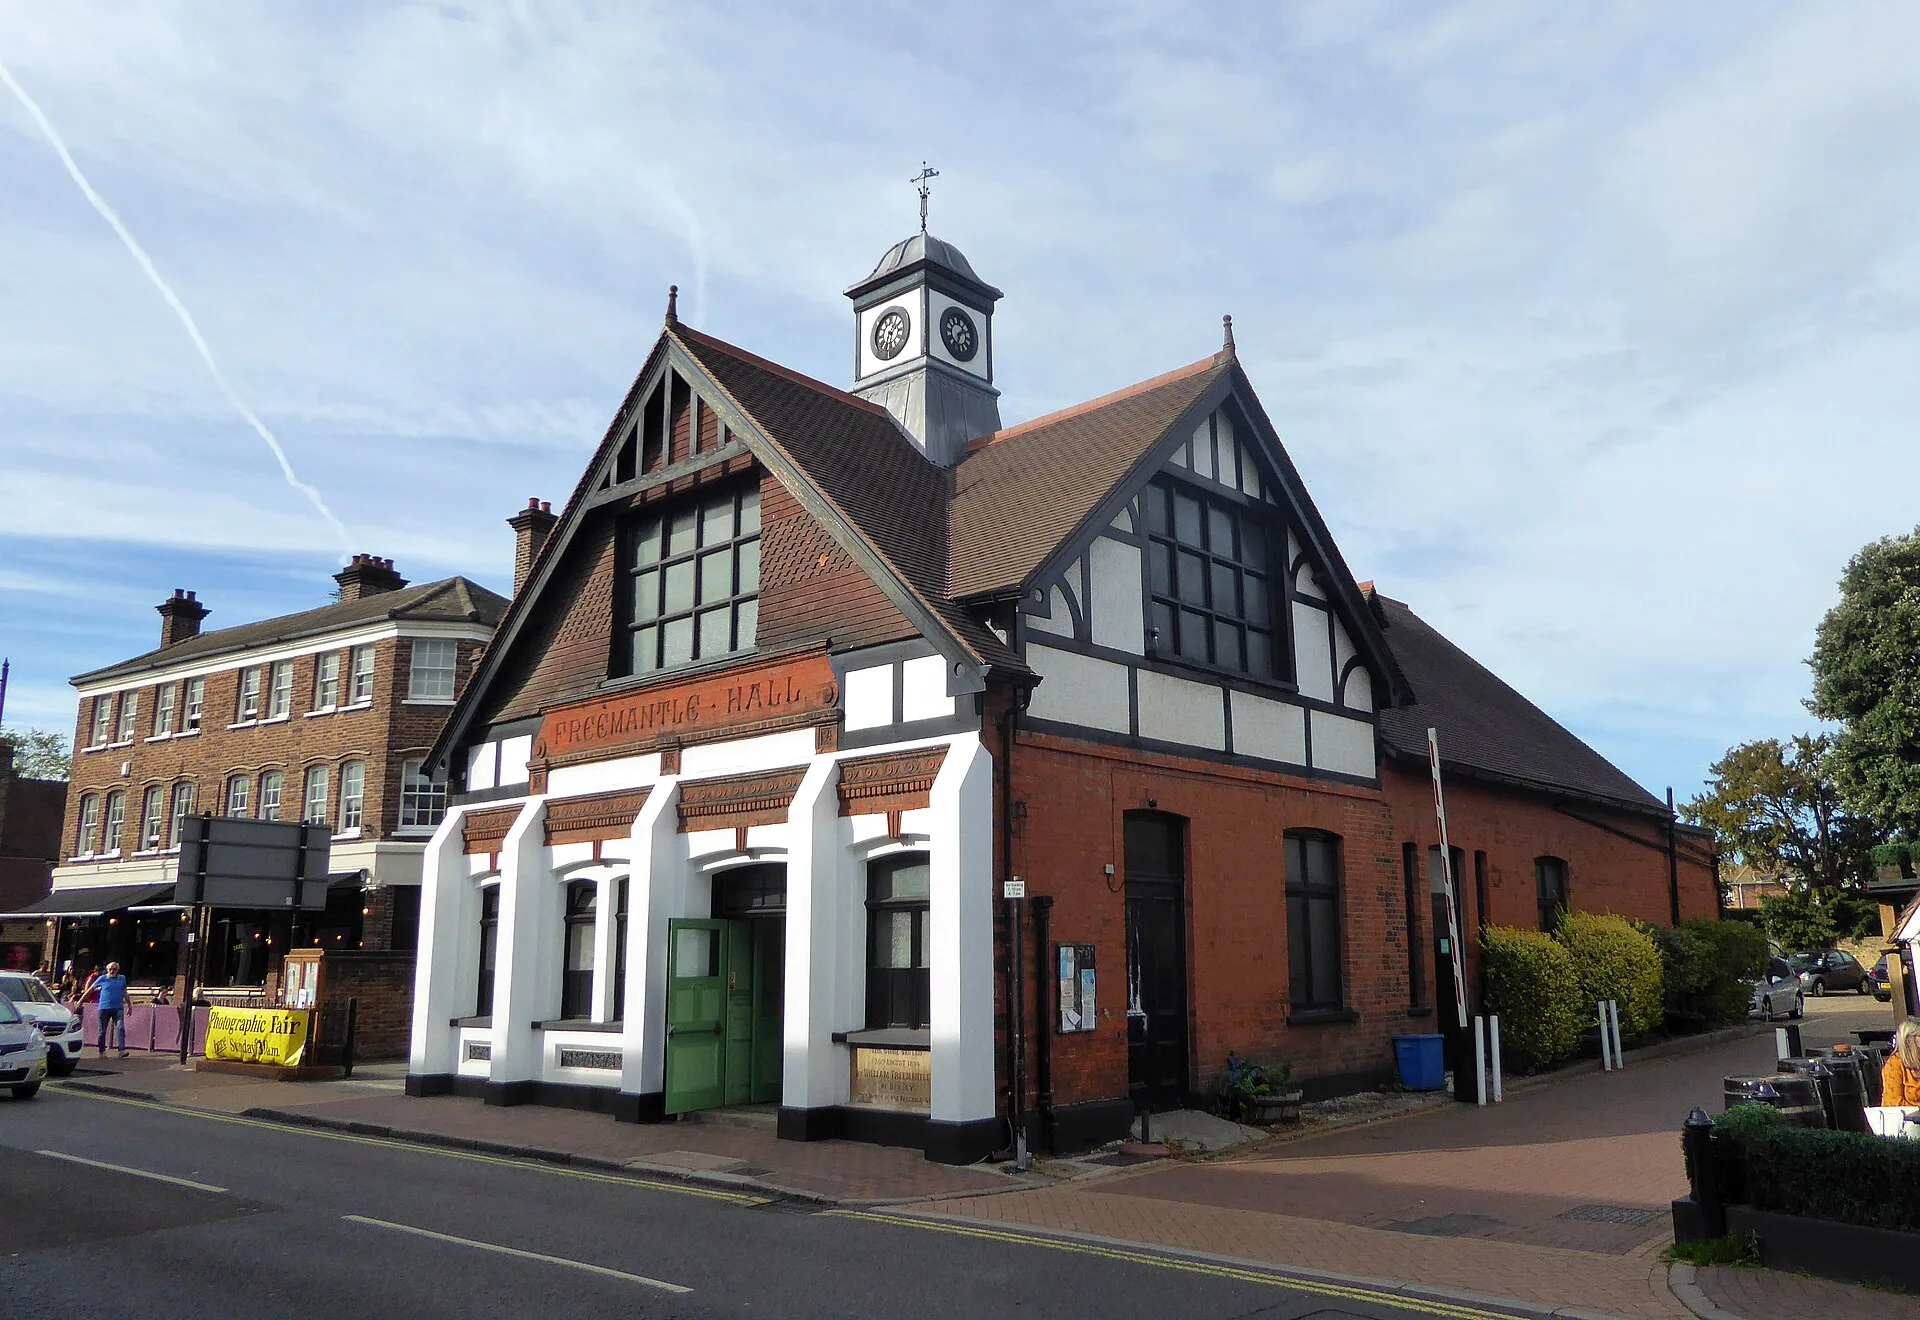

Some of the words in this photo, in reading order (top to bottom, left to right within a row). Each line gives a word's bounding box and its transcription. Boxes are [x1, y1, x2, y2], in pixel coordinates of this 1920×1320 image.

[554, 695, 700, 745] FREEMANTLE
[727, 677, 801, 713] HALL
[210, 1012, 266, 1035] Photographic
[270, 1015, 301, 1034] Fair
[863, 1069, 890, 1079] WILLIAM
